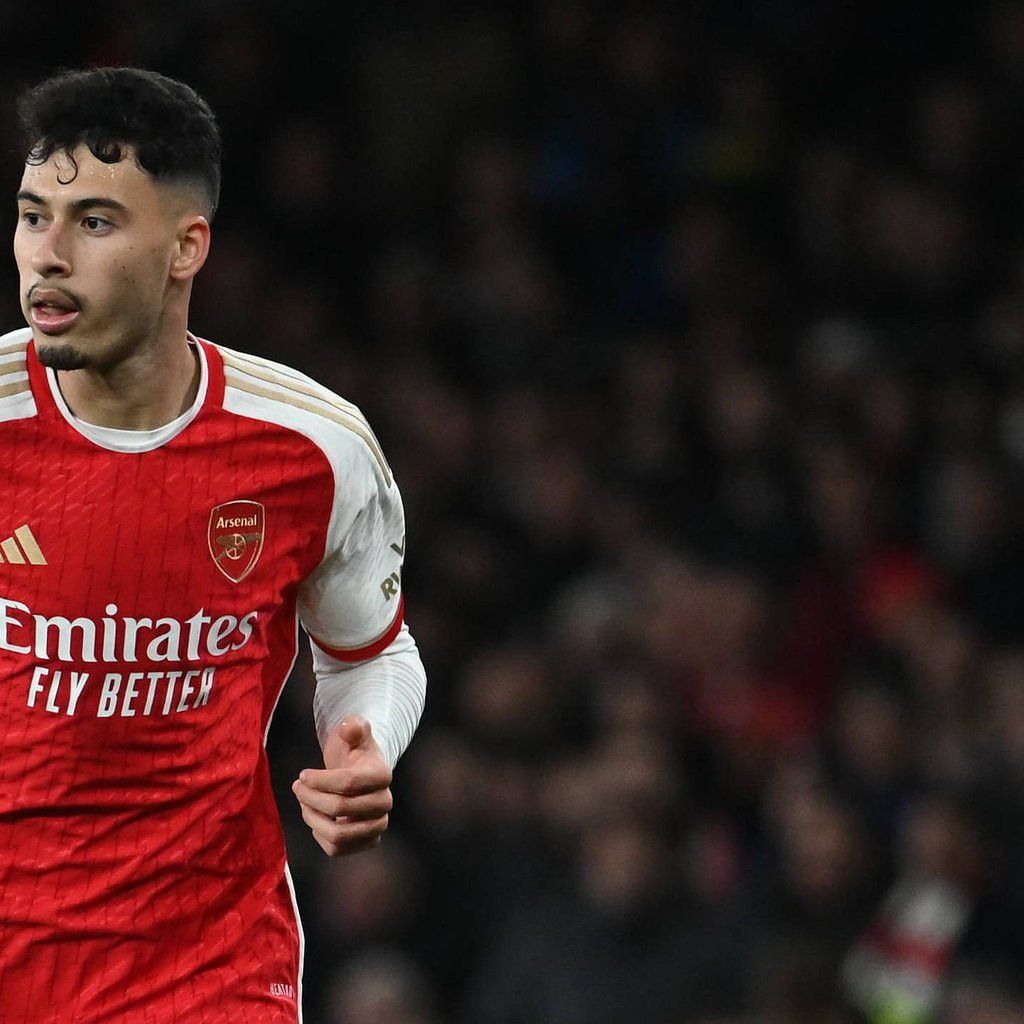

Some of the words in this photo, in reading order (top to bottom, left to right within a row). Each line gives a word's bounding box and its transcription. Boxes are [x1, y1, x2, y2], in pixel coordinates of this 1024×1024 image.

[216, 514, 257, 529] Arsenal
[26, 666, 90, 717] FLY
[96, 667, 216, 718] BETTER
